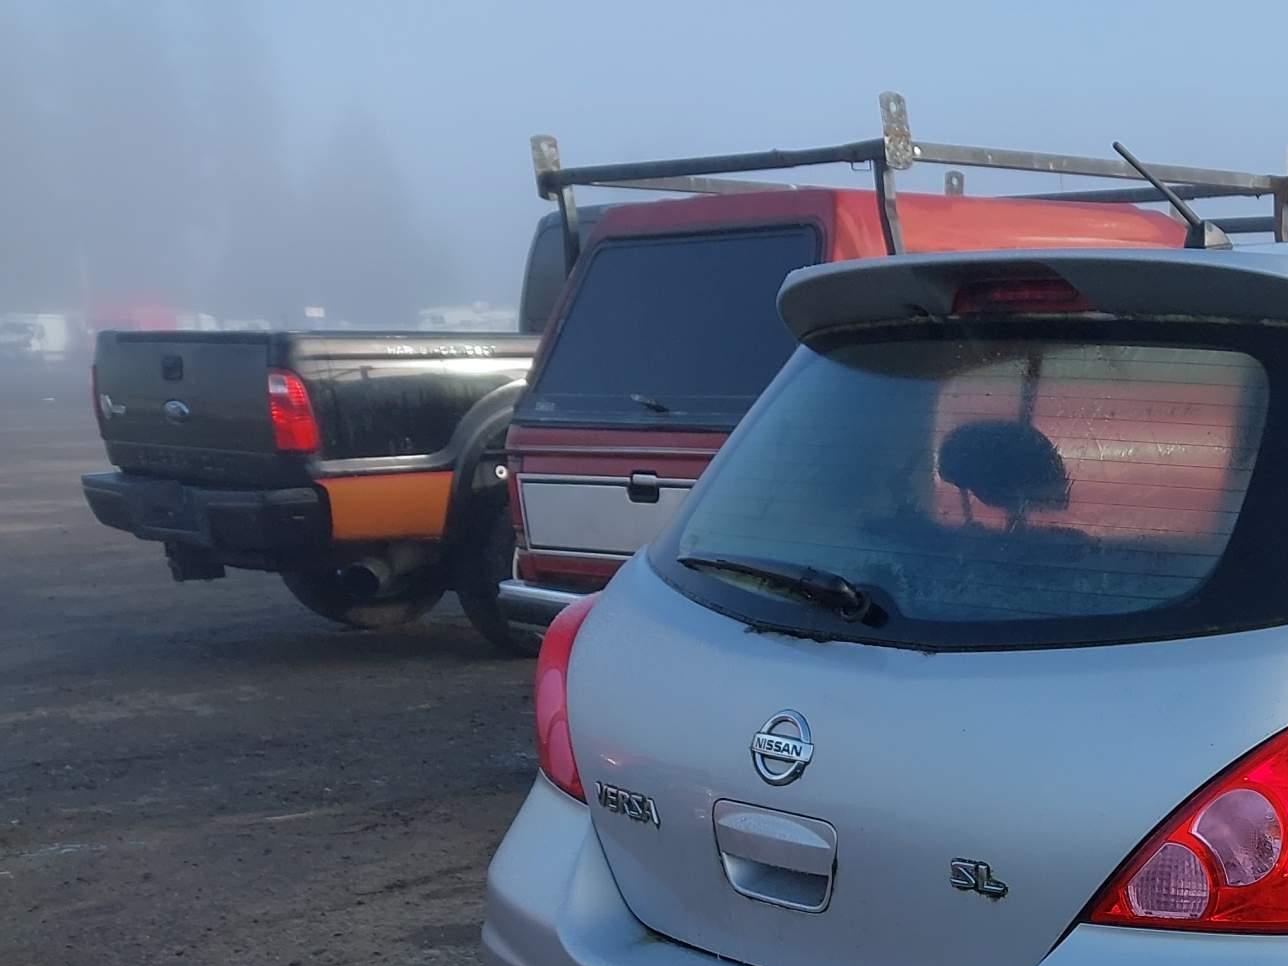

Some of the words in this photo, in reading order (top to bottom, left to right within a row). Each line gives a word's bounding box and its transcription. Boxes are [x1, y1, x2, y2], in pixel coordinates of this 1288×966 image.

[755, 737, 803, 757] NISSAN
[594, 780, 661, 829] VERSA
[950, 857, 1008, 900] SL
